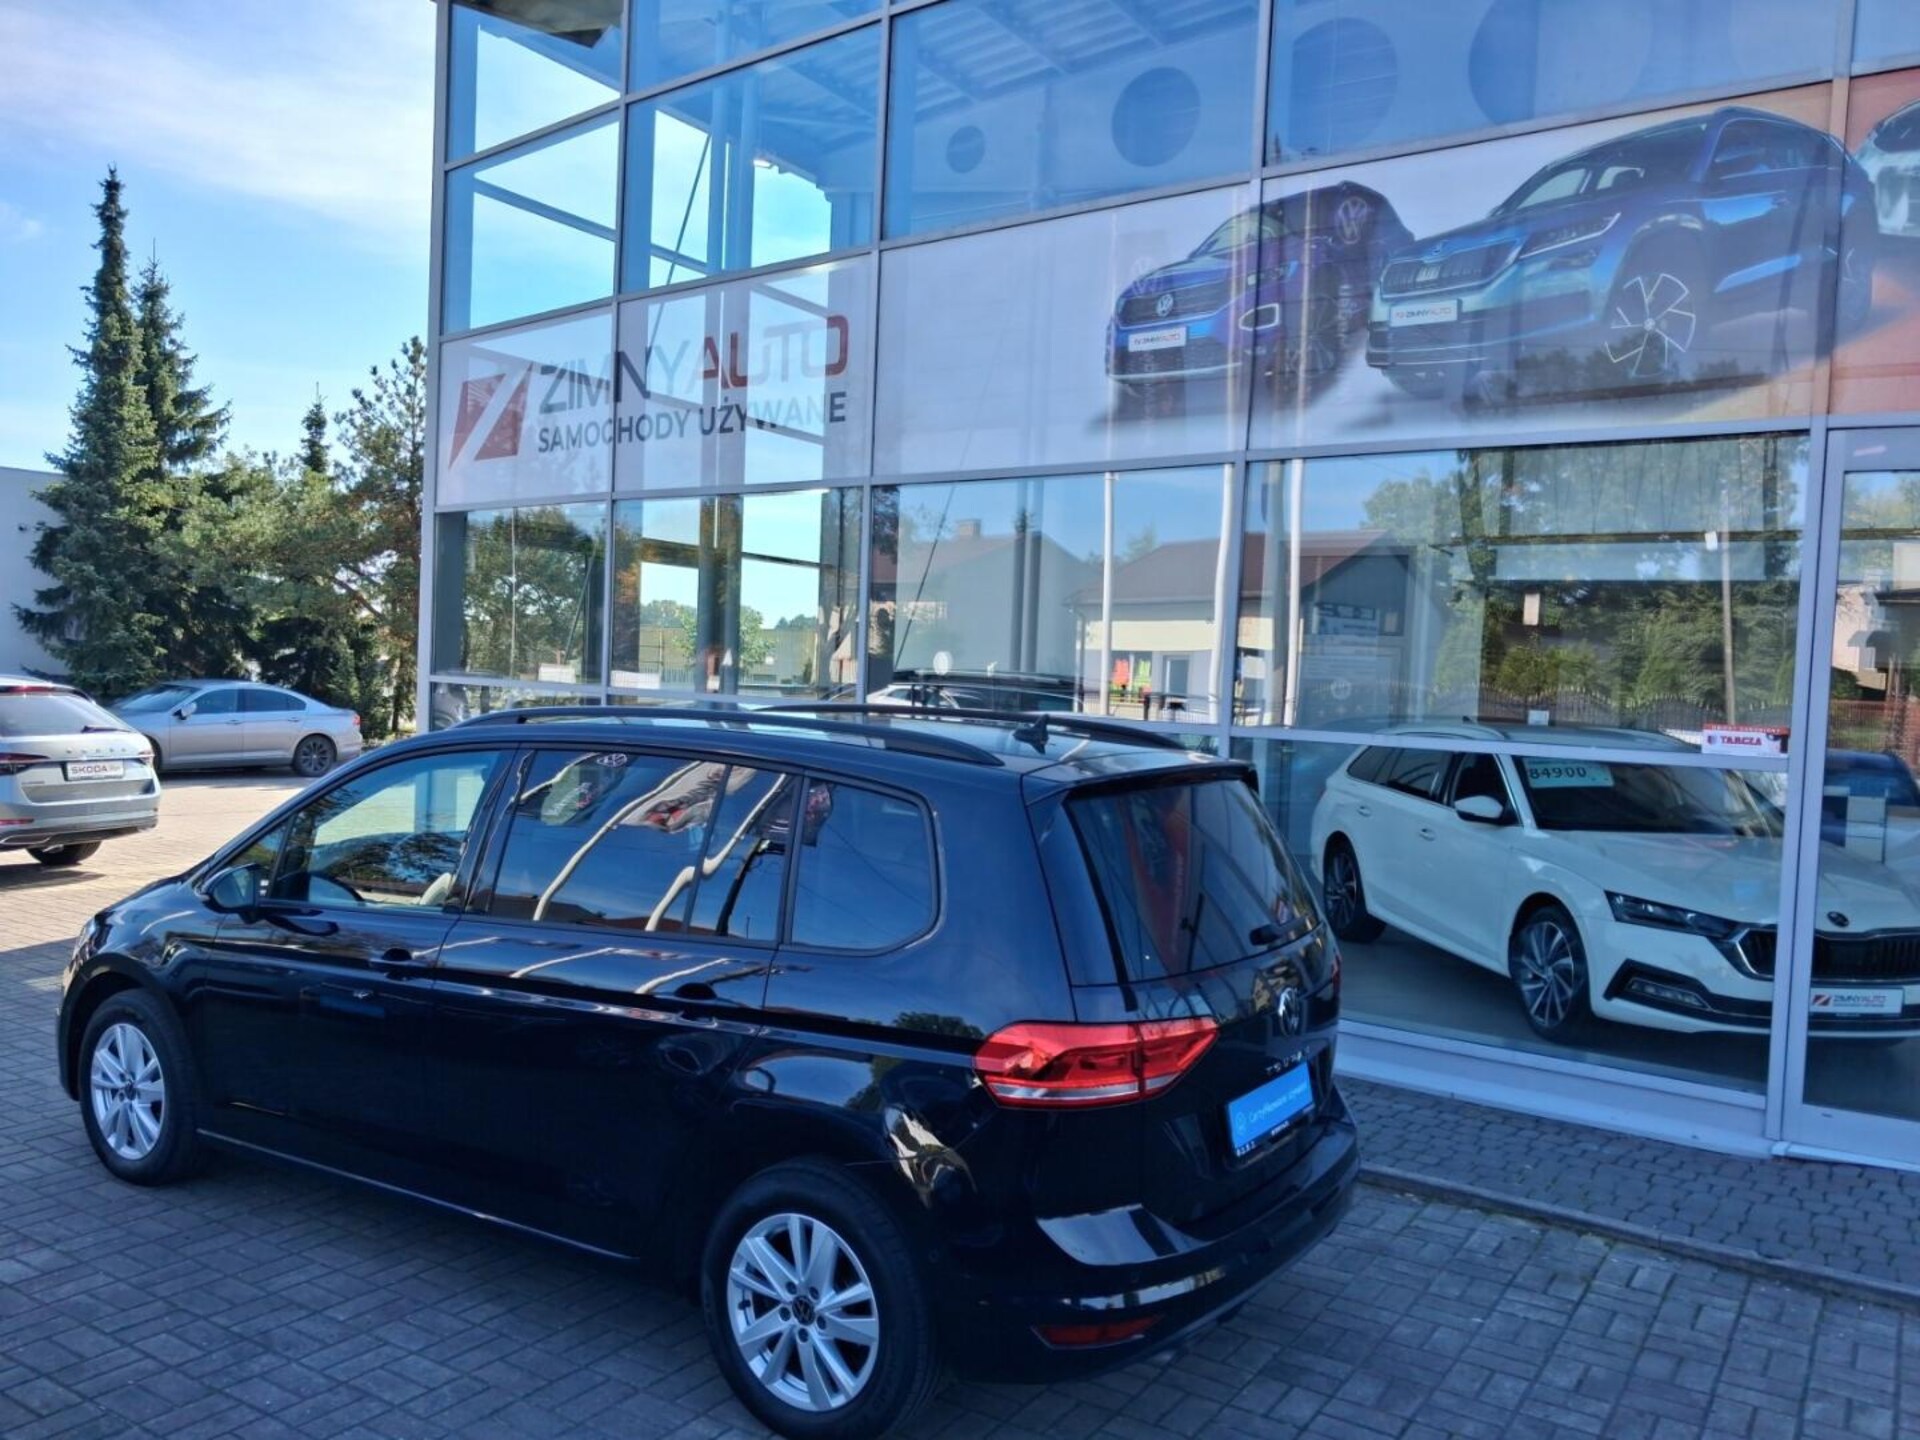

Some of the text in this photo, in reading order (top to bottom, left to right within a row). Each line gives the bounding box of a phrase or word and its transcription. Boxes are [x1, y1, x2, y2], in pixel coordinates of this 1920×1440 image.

[538, 391, 847, 454] SAMOCHODY UŻYWANE
[1529, 766, 1588, 780] 84900
